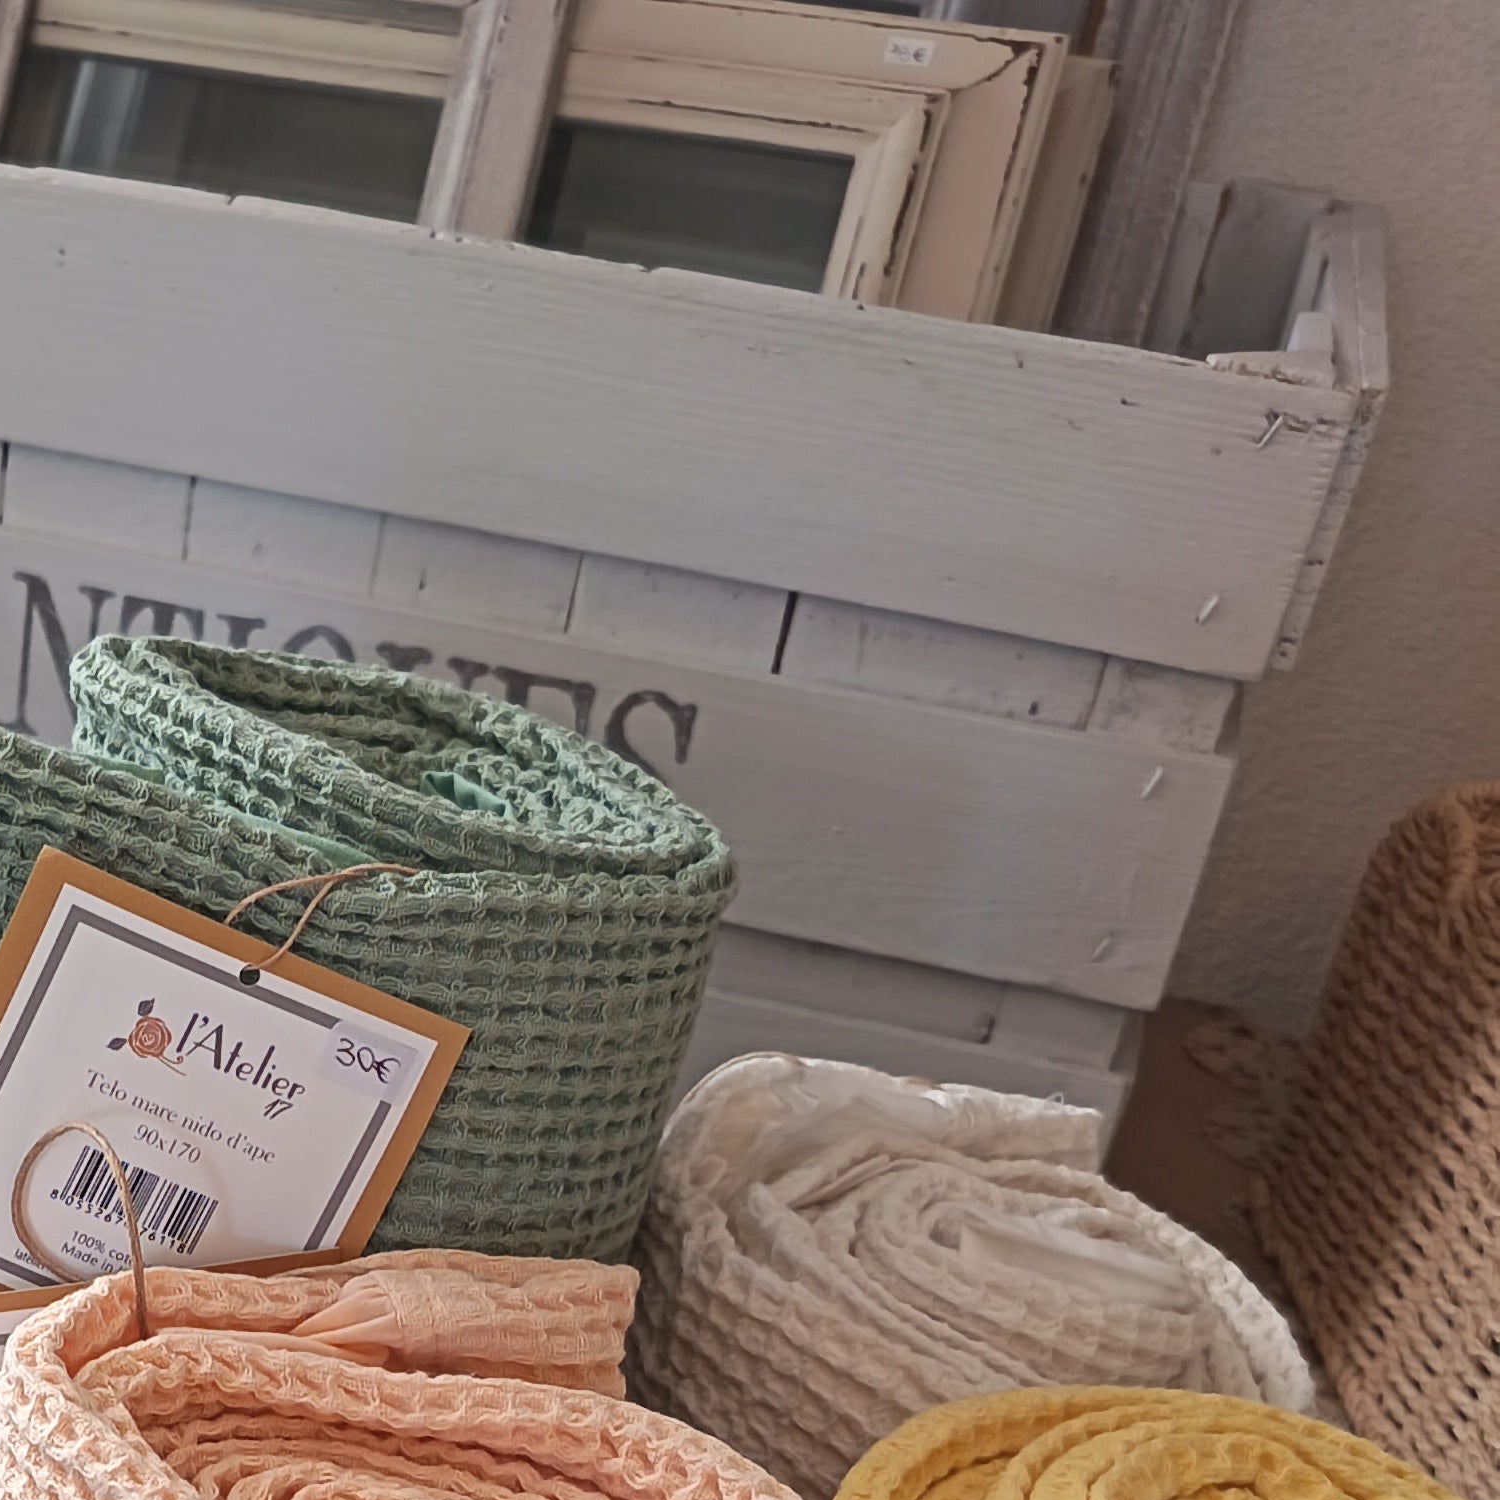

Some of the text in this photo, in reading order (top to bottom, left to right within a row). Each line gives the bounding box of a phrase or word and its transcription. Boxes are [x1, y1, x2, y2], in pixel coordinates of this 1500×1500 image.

[176, 1012, 306, 1100] l'Atelier
[334, 1037, 401, 1084] 30€
[87, 1069, 276, 1164] Telo mare nido d'ape
[263, 1099, 294, 1119] 17
[133, 1124, 201, 1164] 90x170
[61, 1242, 98, 1266] Made
[101, 1259, 114, 1273] in
[72, 1231, 106, 1253] 100%
